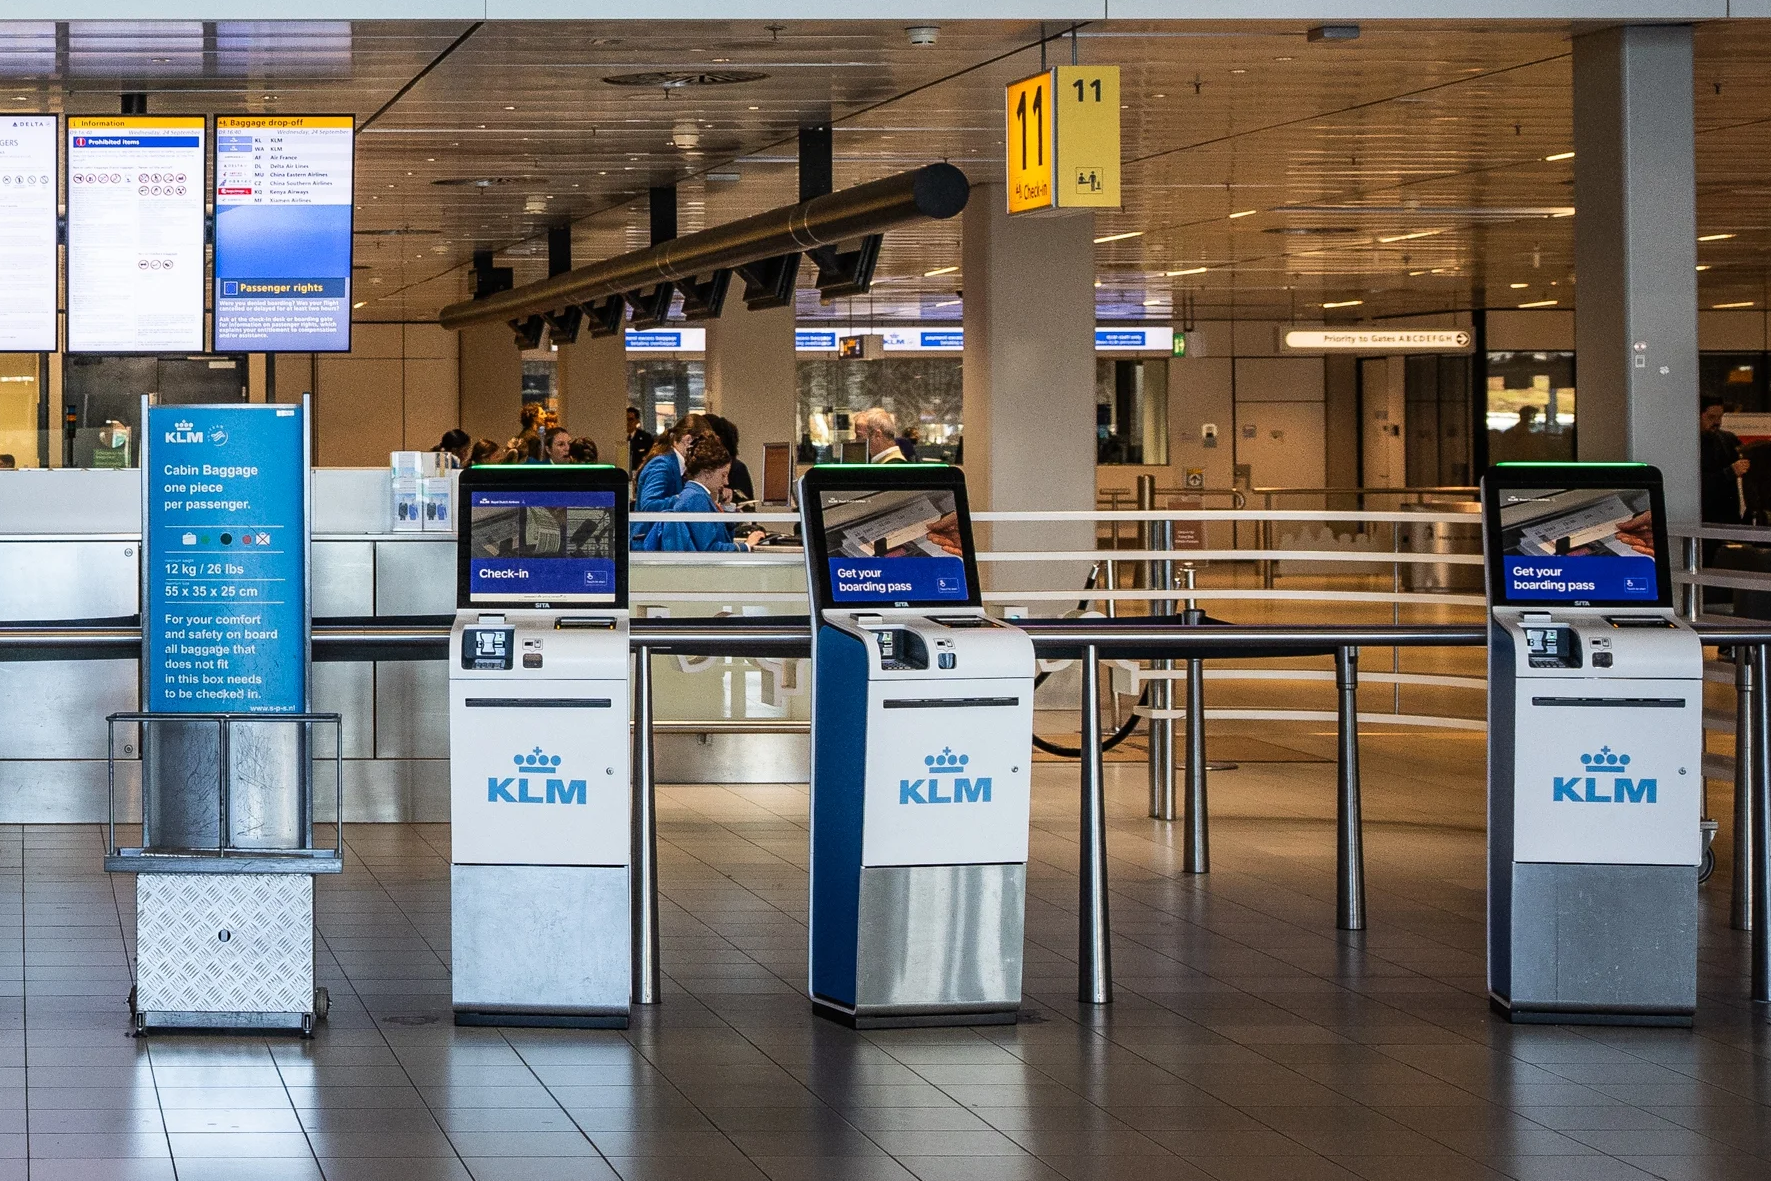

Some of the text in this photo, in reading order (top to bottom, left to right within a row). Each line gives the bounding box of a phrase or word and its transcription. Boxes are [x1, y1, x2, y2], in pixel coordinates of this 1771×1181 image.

[1073, 79, 1101, 102] 11
[230, 119, 304, 127] Baggage drop-off
[1017, 85, 1043, 170] 11
[1024, 183, 1048, 200] Check-in
[240, 283, 323, 293] Passenger rights
[1324, 335, 1356, 343] Priority
[165, 432, 203, 443] KLM
[164, 465, 258, 478] Cabin Baggage
[164, 482, 223, 495] one piece
[164, 501, 251, 511] per passenger.
[165, 564, 244, 576] 12 kg / 26 lbs
[479, 569, 529, 579] Check-in
[838, 569, 882, 580] Get your
[1513, 566, 1562, 578] Get your
[165, 586, 258, 596] 55 x 35 x 25 cm
[839, 581, 912, 593] boarding pass
[1514, 580, 1595, 592] boarding pass
[165, 614, 261, 626] For your comfort
[165, 629, 185, 639] and
[188, 629, 223, 641] safety
[245, 629, 278, 639] board
[165, 644, 256, 656] all baggage that
[165, 659, 228, 669] does not fit
[165, 674, 262, 683] in this box needs
[165, 689, 261, 699] to be checked in.
[488, 776, 587, 805] KLM
[899, 776, 992, 805] KLM
[1553, 776, 1657, 803] KLM
